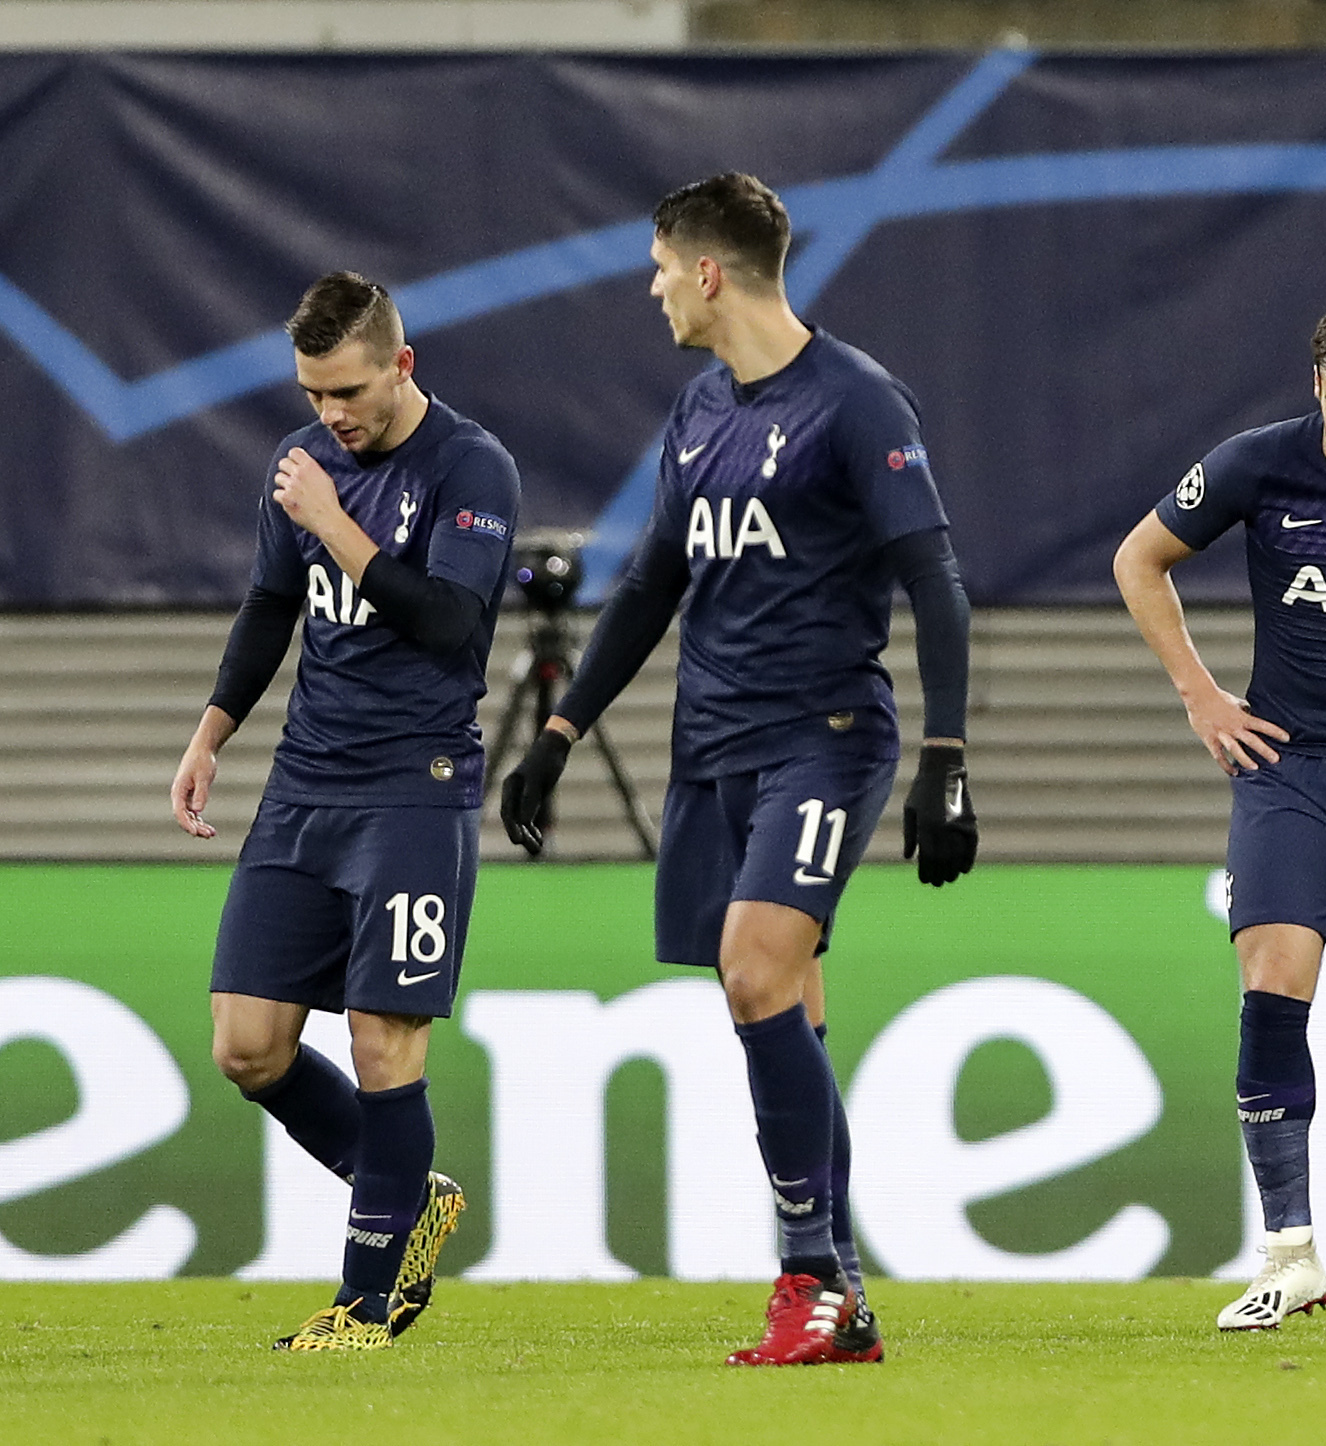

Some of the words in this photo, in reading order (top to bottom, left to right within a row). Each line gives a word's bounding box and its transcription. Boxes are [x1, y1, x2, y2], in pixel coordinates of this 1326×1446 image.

[686, 496, 787, 559] AIA
[795, 798, 848, 877] 11
[385, 893, 446, 963] 18
